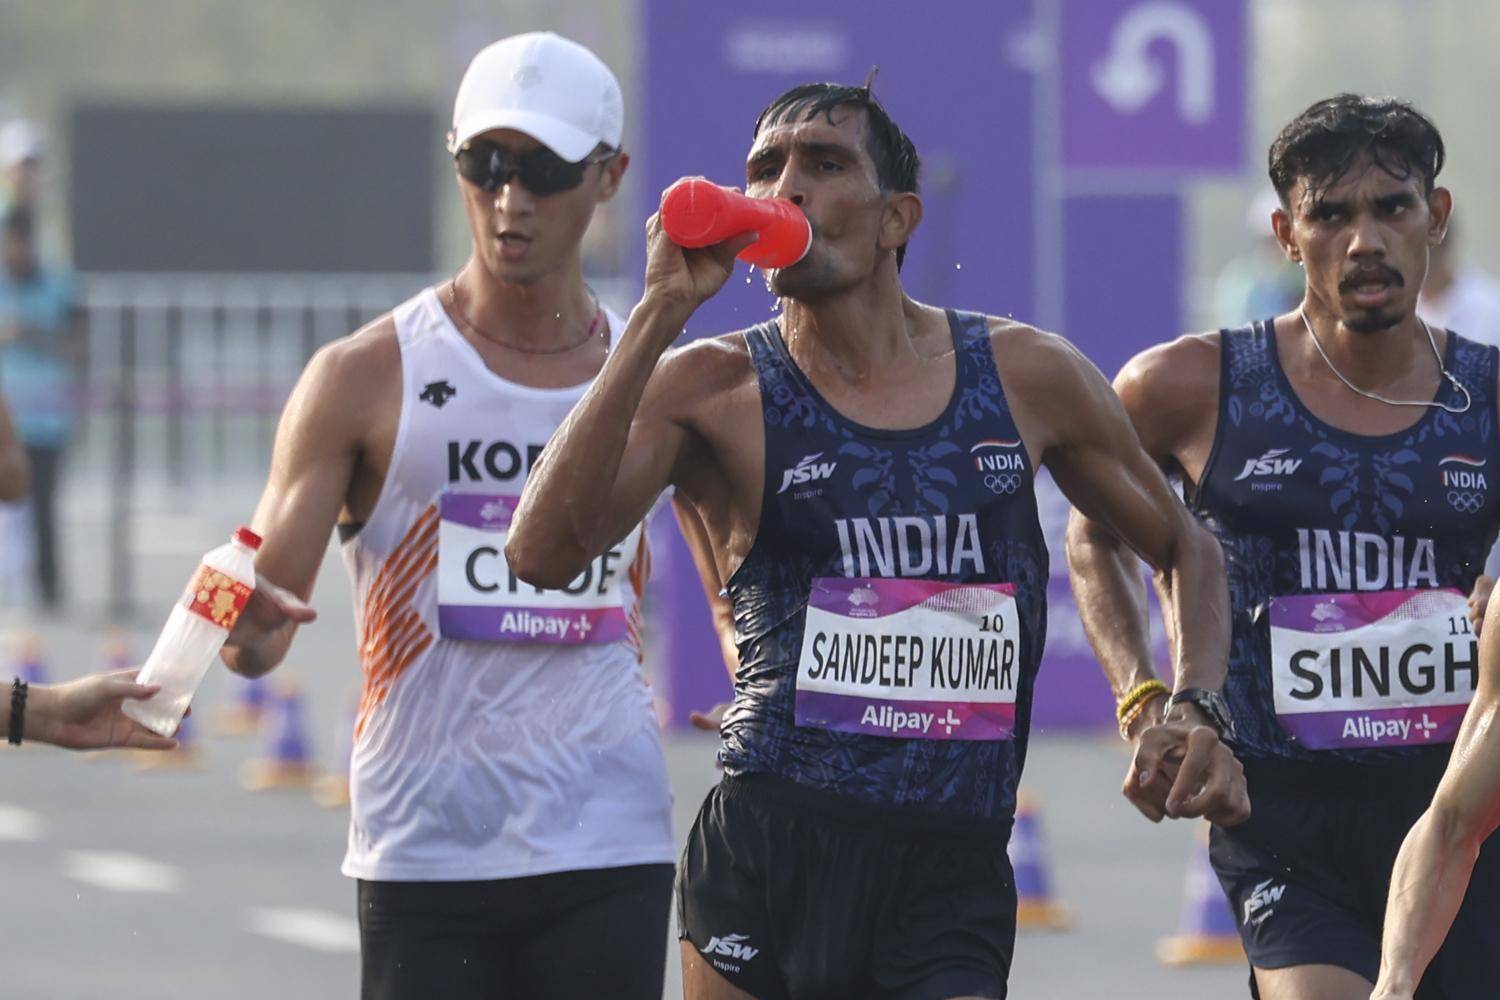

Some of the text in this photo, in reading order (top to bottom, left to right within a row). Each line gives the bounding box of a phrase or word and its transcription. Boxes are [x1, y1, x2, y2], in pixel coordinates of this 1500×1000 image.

[974, 453, 1025, 472] INDIA
[1233, 459, 1303, 481] JSW
[776, 461, 838, 495] JSW
[1440, 470, 1488, 491] INDIA
[834, 513, 986, 578] INDIA
[1296, 528, 1440, 591] INDIA
[979, 614, 1004, 633] 10
[1449, 616, 1471, 636] 11
[807, 631, 1014, 691] SANDEEP KUMAR
[1289, 641, 1479, 701] SINGH
[700, 936, 760, 962] JSW
